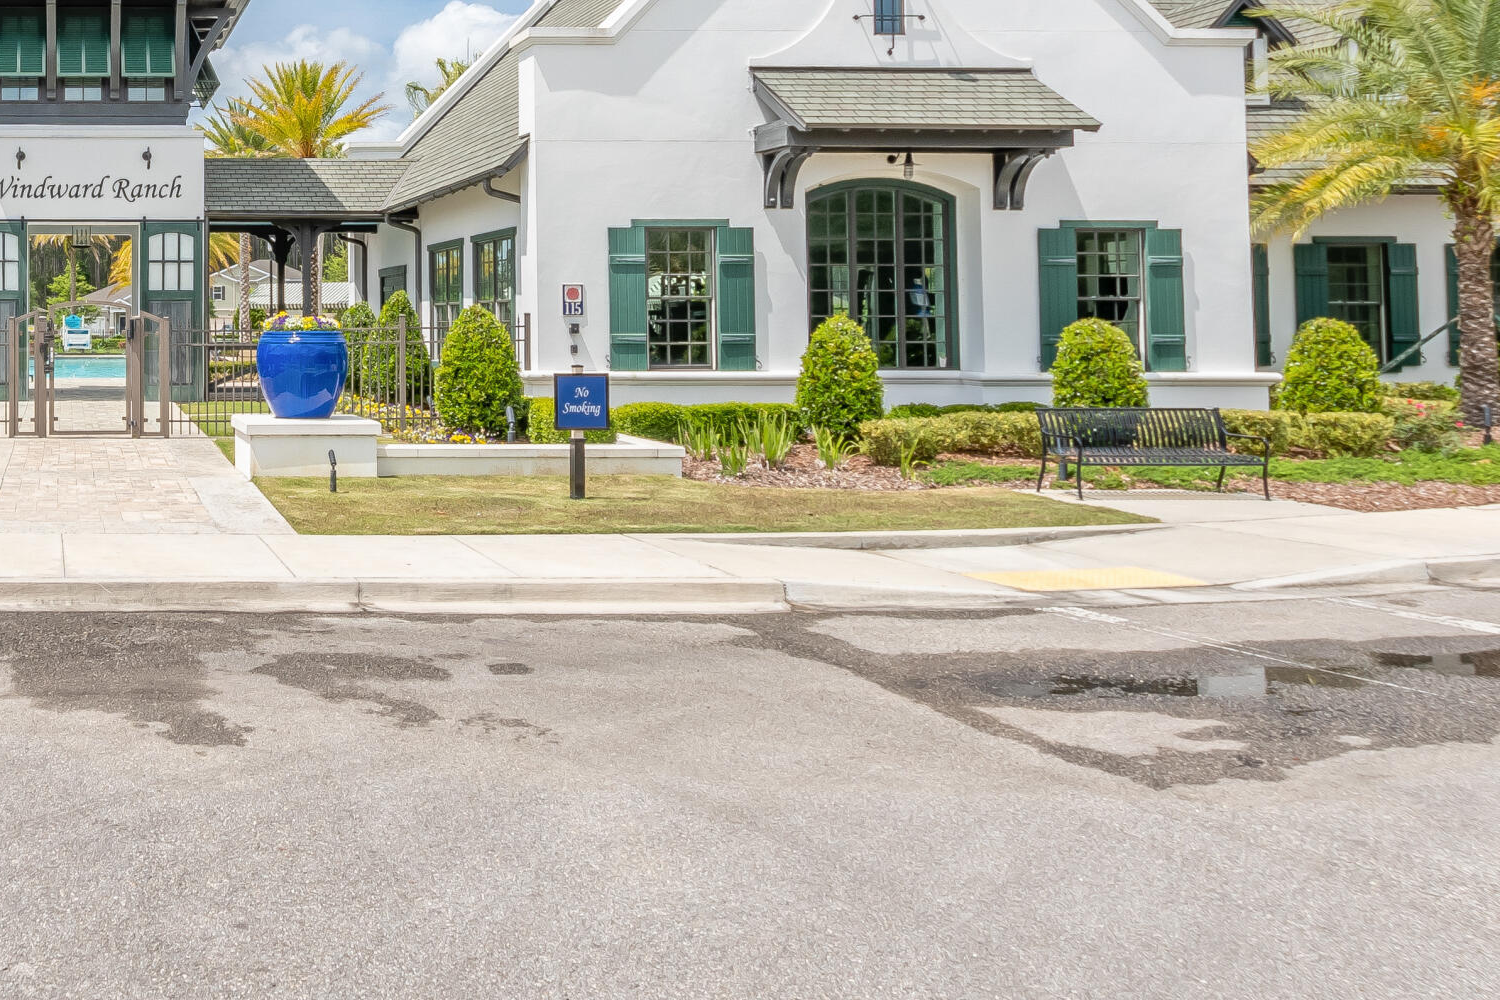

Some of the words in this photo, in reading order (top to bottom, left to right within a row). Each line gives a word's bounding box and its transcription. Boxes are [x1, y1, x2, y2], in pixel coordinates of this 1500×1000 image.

[112, 175, 182, 202] Ranch
[564, 302, 582, 315] 115
[574, 386, 589, 398] No
[562, 401, 601, 416] Smoking
